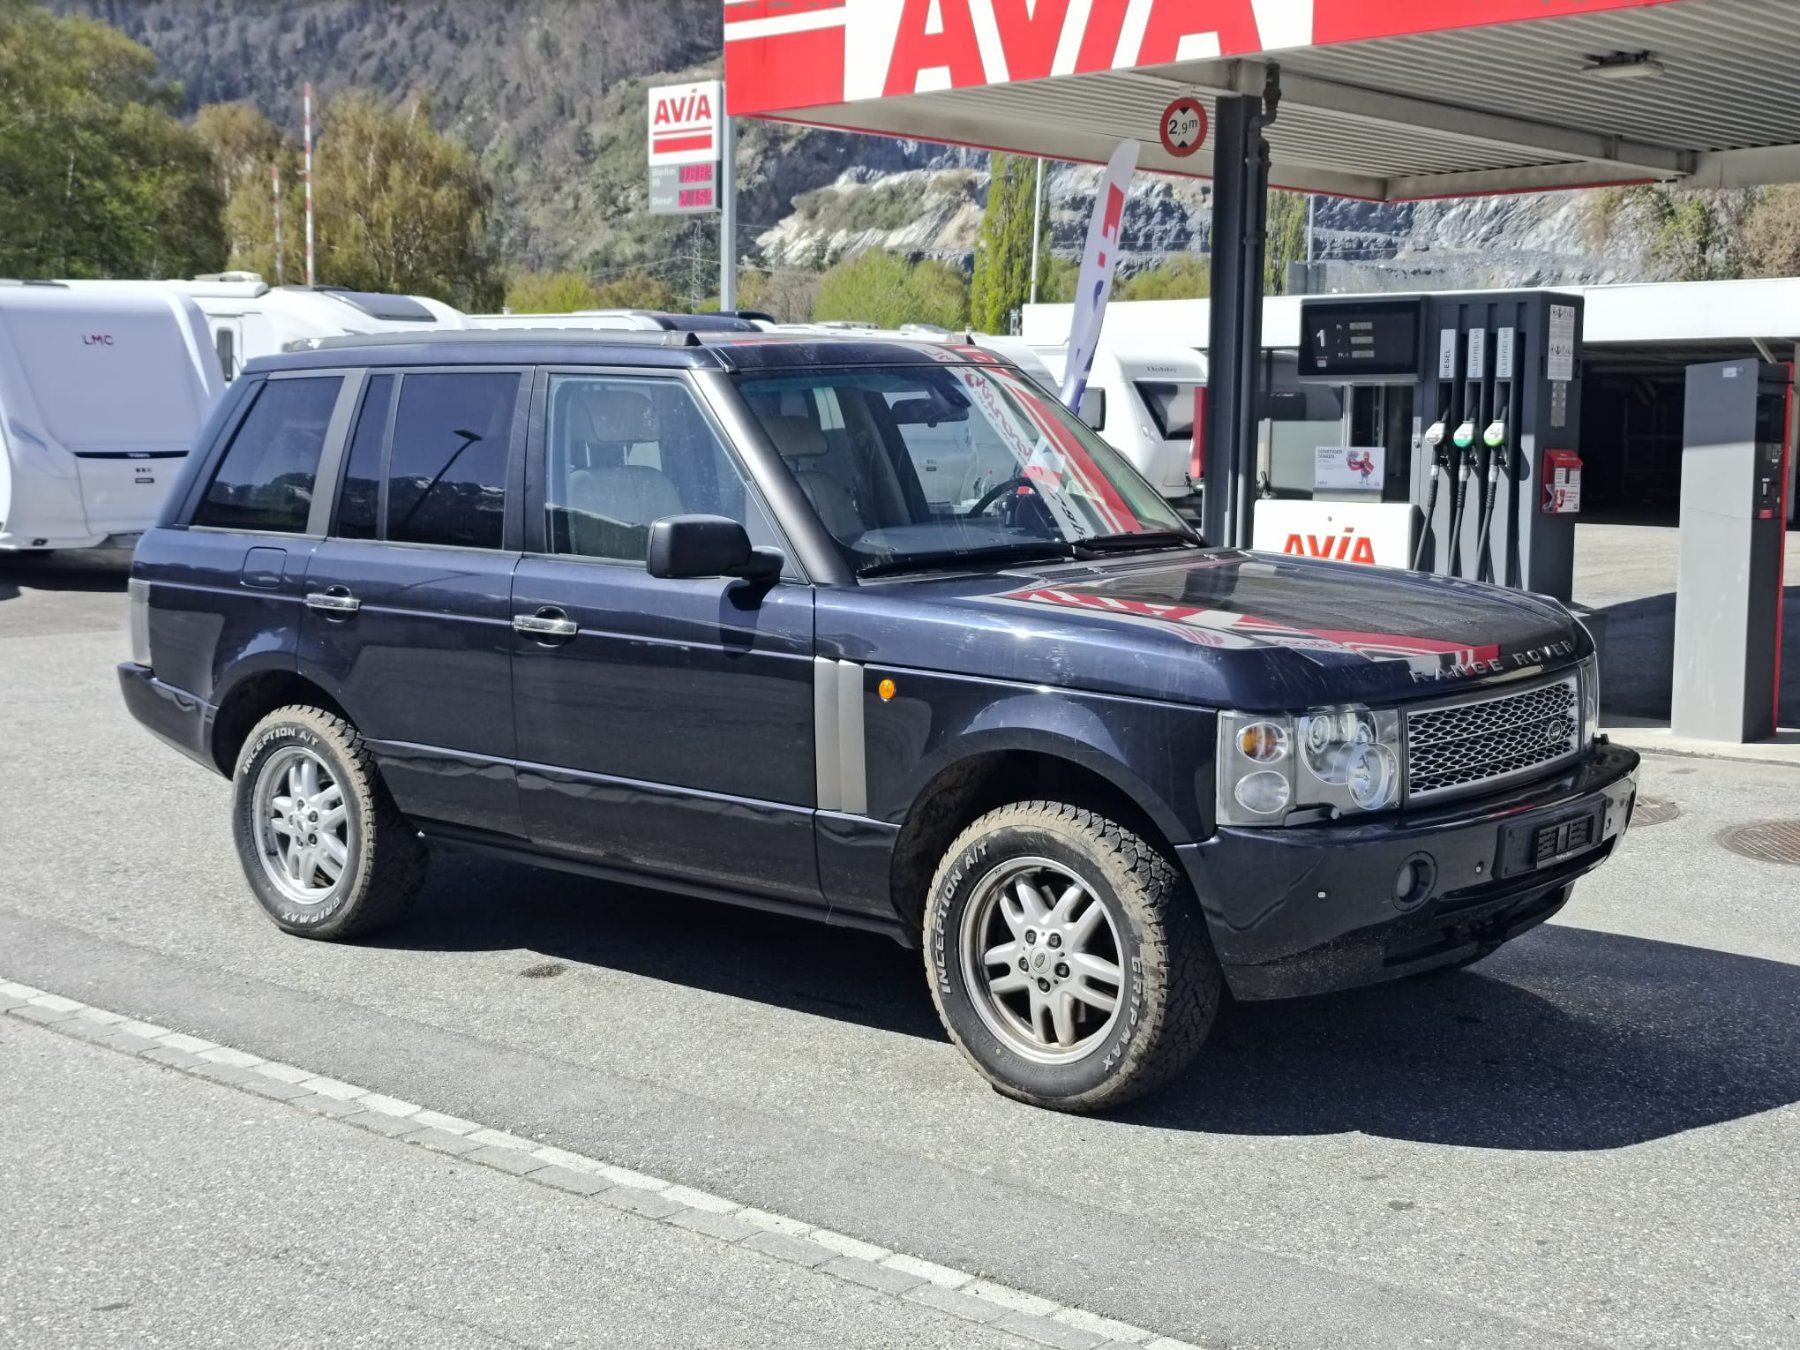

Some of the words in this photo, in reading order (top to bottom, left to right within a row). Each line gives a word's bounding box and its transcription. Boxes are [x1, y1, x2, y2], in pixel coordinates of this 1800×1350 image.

[81, 334, 114, 345] LMC
[1316, 329, 1326, 347] 1
[1409, 658, 1504, 683] RANGE
[1512, 639, 1576, 666] ROVER
[242, 727, 297, 775] INCEPTION
[300, 731, 320, 747] A/T
[282, 896, 341, 924] GRIPMAX
[932, 871, 964, 995] INCEPTION
[965, 843, 990, 870] A/T
[1104, 956, 1146, 1072] GRIPMAX
